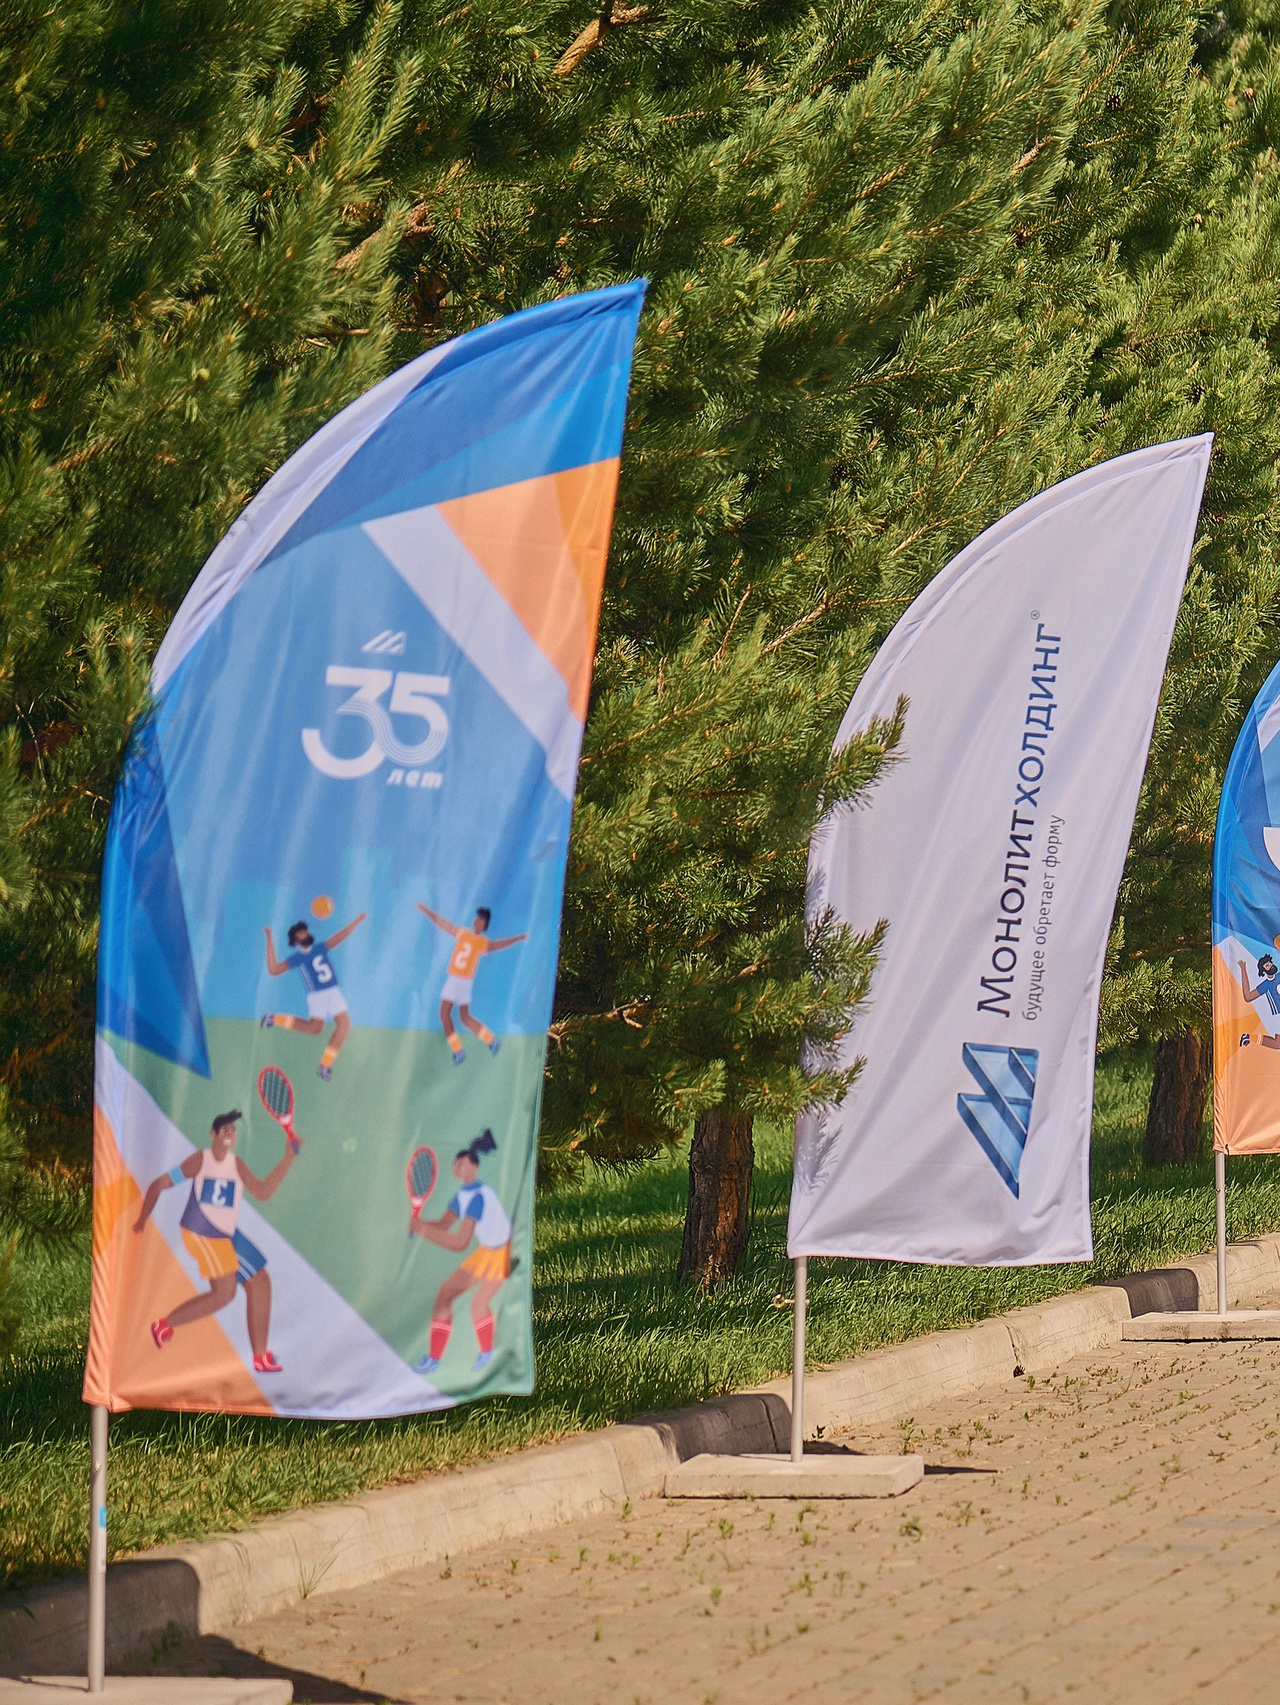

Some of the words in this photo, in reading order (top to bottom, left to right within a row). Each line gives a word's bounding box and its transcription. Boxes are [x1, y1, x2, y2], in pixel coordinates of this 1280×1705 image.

[302, 665, 451, 779] 35
[386, 768, 443, 789] лет
[1042, 814, 1065, 868] форму
[1033, 872, 1055, 945] обретает
[1022, 950, 1045, 1021] будущее
